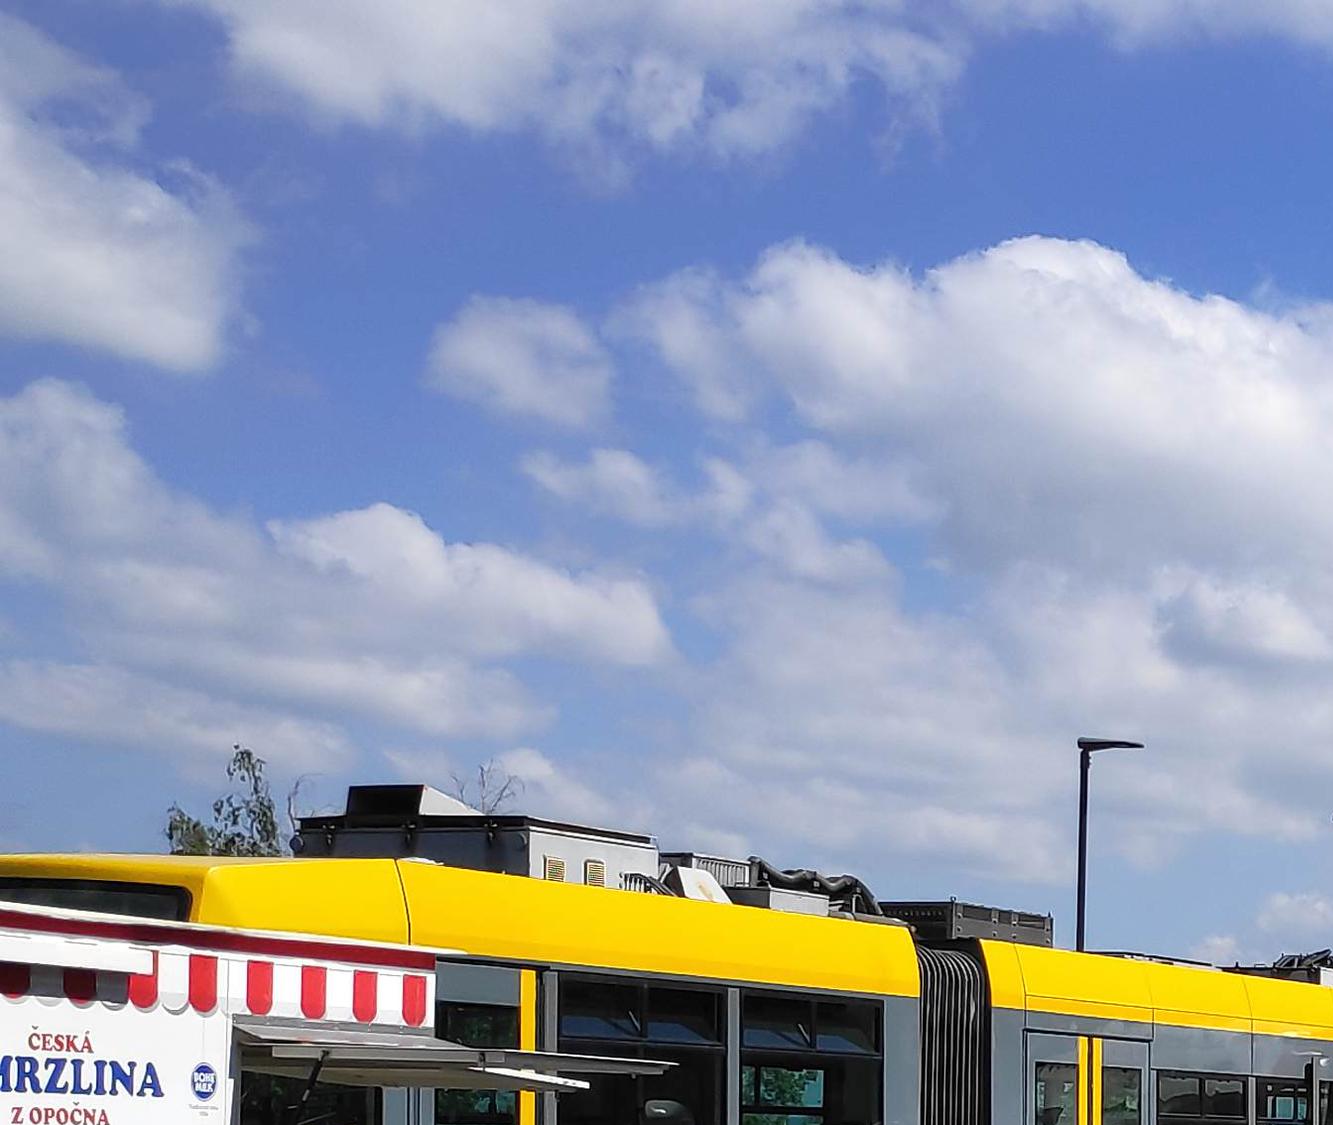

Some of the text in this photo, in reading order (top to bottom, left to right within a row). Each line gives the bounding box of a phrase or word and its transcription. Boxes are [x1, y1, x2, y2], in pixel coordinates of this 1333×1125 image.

[28, 1025, 94, 1053] ČESKÁ
[11, 1101, 110, 1125] Z OPOČNA
